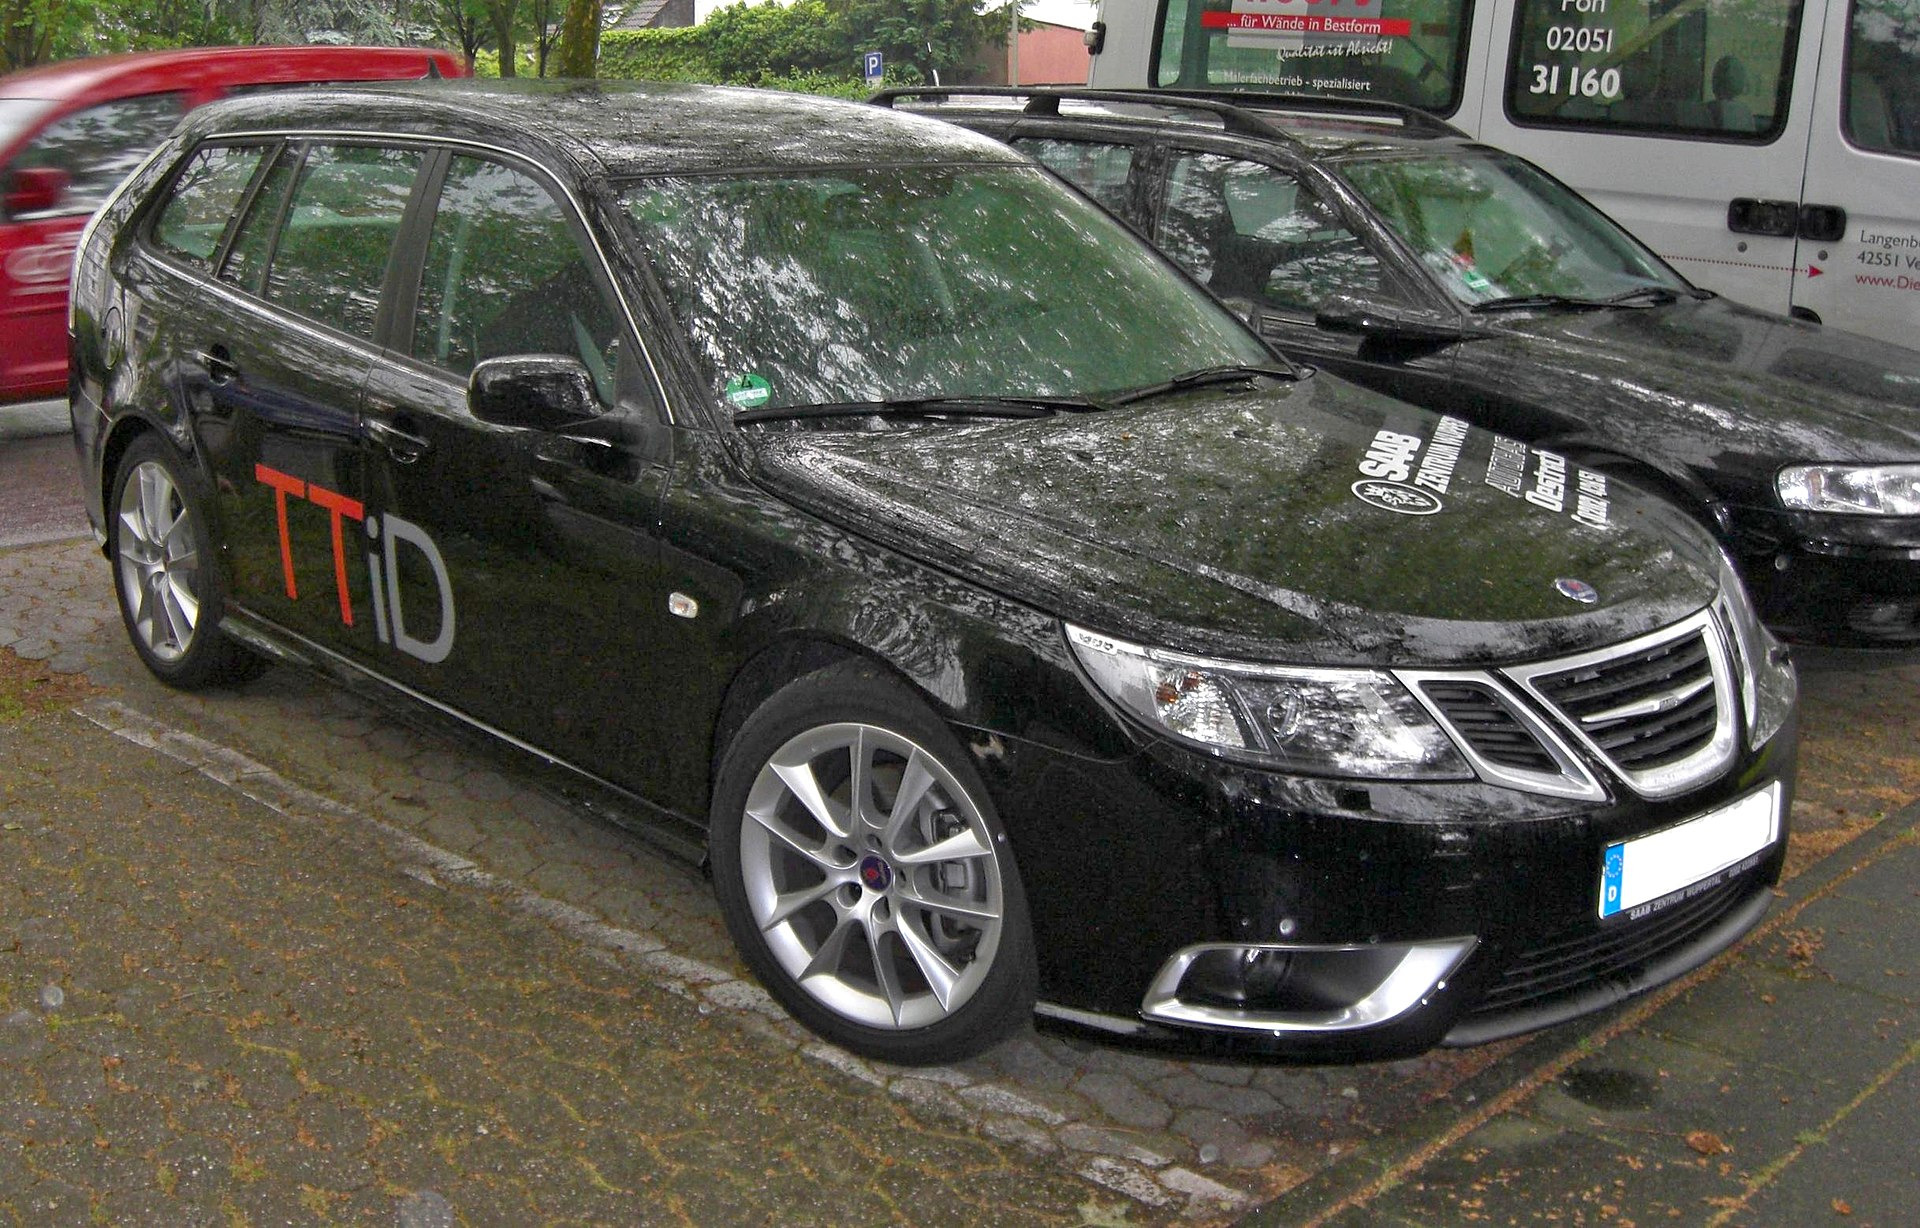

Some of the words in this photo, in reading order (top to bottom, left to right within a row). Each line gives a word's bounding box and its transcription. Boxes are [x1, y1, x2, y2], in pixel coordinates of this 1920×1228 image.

[1240, 15, 1258, 28] für
[1262, 15, 1305, 30] Wände
[1308, 19, 1320, 30] in
[1324, 18, 1381, 34] Bestform
[1546, 26, 1613, 53] 02051
[1277, 46, 1325, 62] Qualität
[1327, 44, 1344, 56] ist
[1345, 39, 1394, 56] Absicht!
[869, 56, 878, 75] P
[1223, 71, 1303, 86] Malerfachbetrieb
[1312, 79, 1371, 92] spezialisiert
[1529, 64, 1559, 95] 31
[1569, 67, 1620, 98] 160
[1860, 229, 1920, 250] Langenb
[1857, 250, 1899, 267] 42551
[1358, 430, 1421, 481] SAAB
[255, 463, 456, 664] TTiD
[1608, 886, 1617, 902] D
